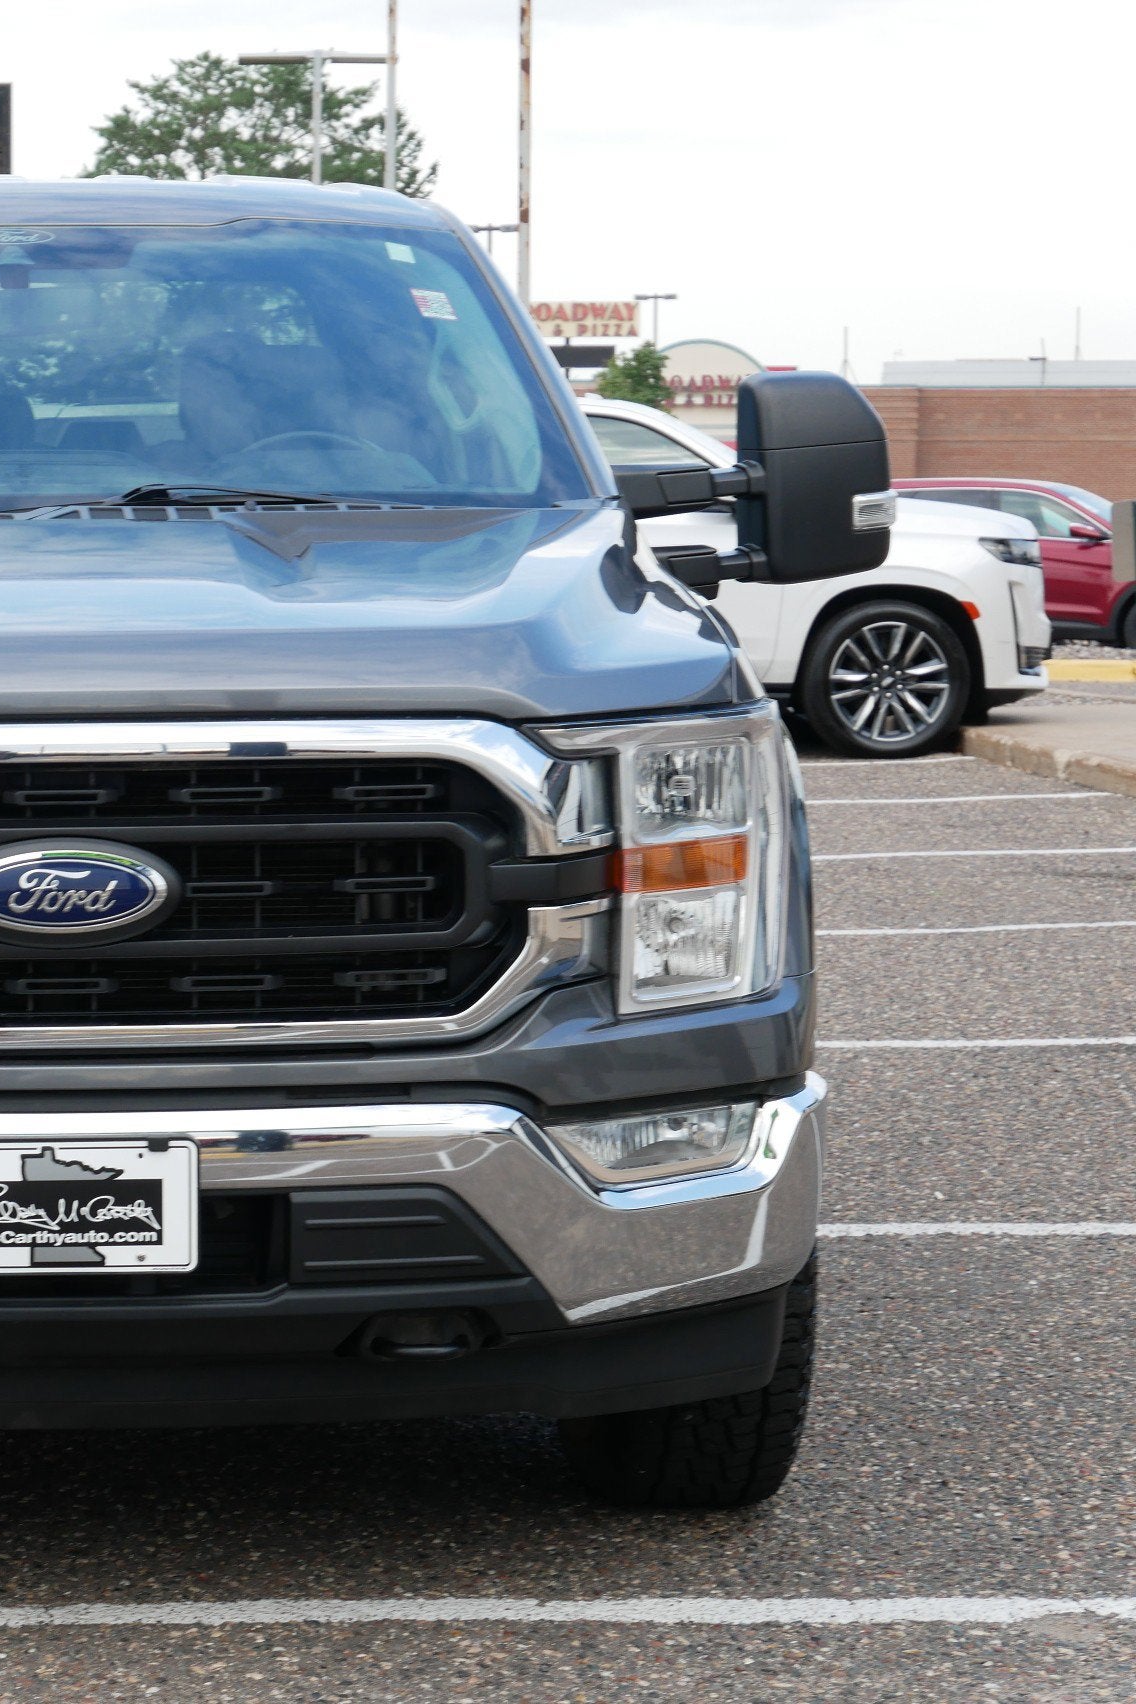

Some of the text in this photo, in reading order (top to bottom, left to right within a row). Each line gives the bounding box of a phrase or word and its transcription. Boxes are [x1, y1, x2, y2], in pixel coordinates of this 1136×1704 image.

[529, 302, 639, 321] OADWAY
[577, 323, 638, 337] PIZZA
[8, 868, 118, 914] Ford
